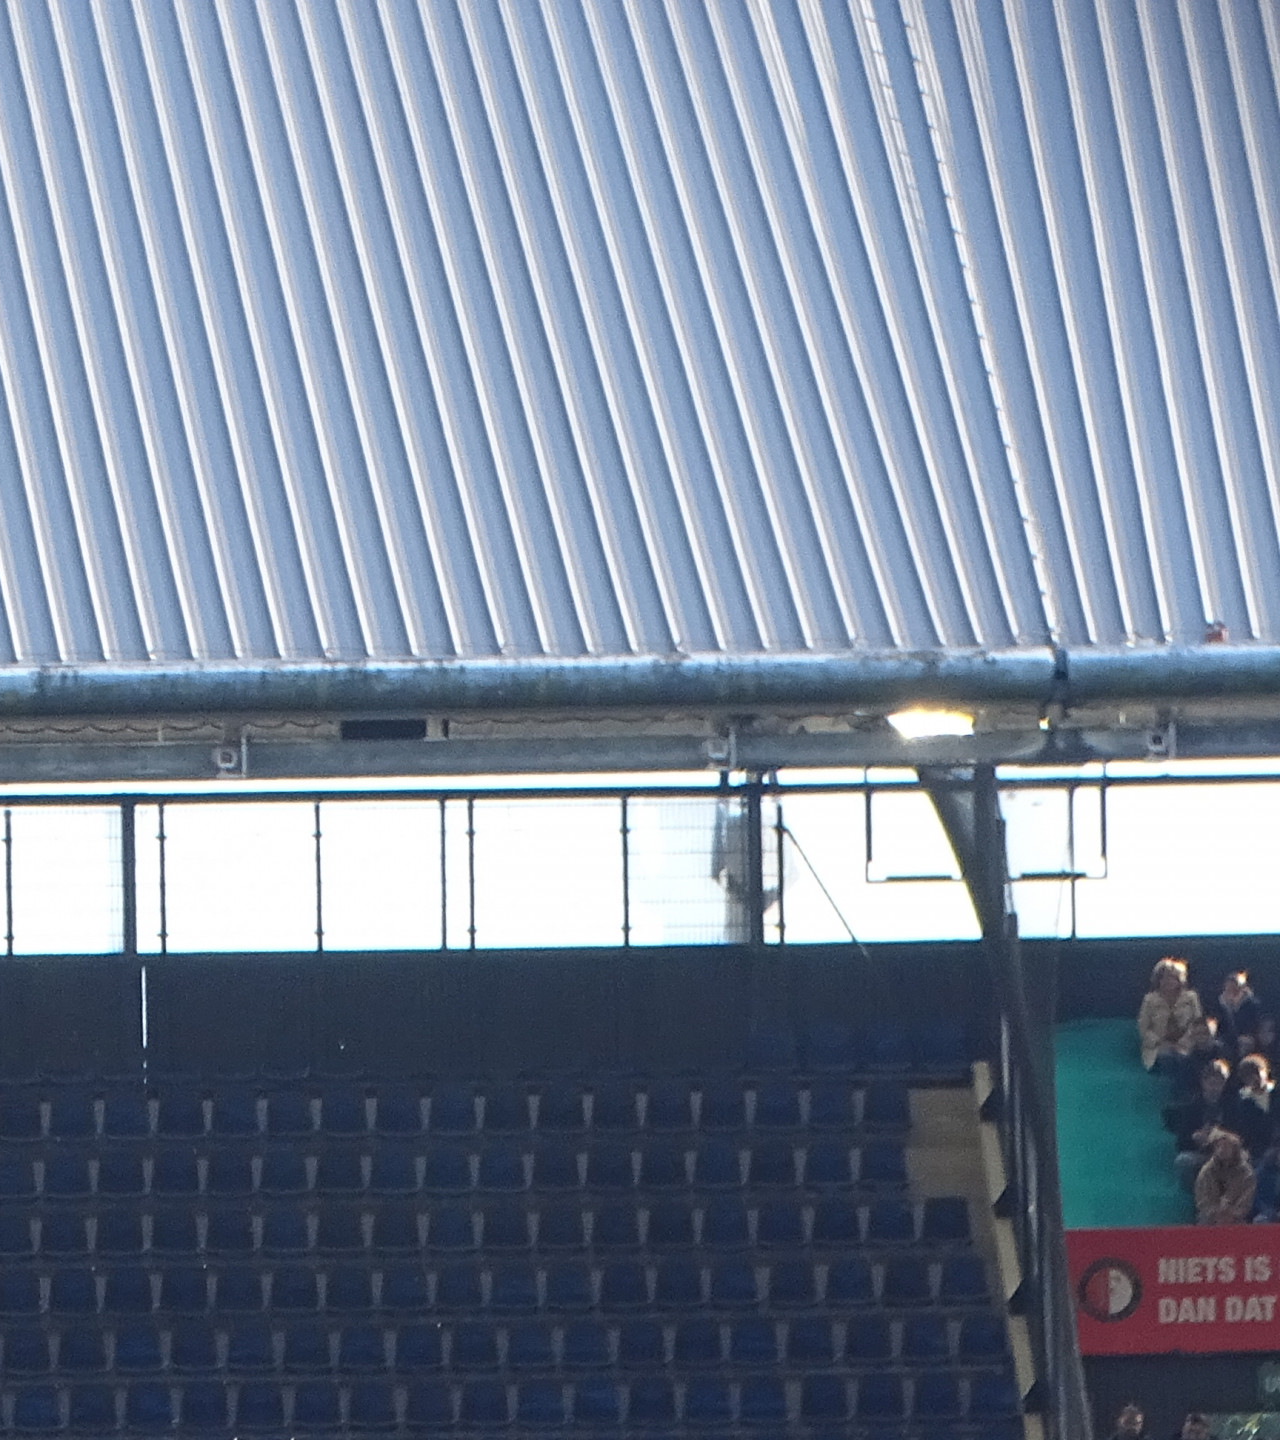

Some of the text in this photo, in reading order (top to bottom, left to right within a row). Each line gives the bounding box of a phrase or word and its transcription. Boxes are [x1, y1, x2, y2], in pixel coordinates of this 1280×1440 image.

[1158, 1255, 1272, 1284] NIETS IS
[1158, 1296, 1277, 1324] DAN DAT
